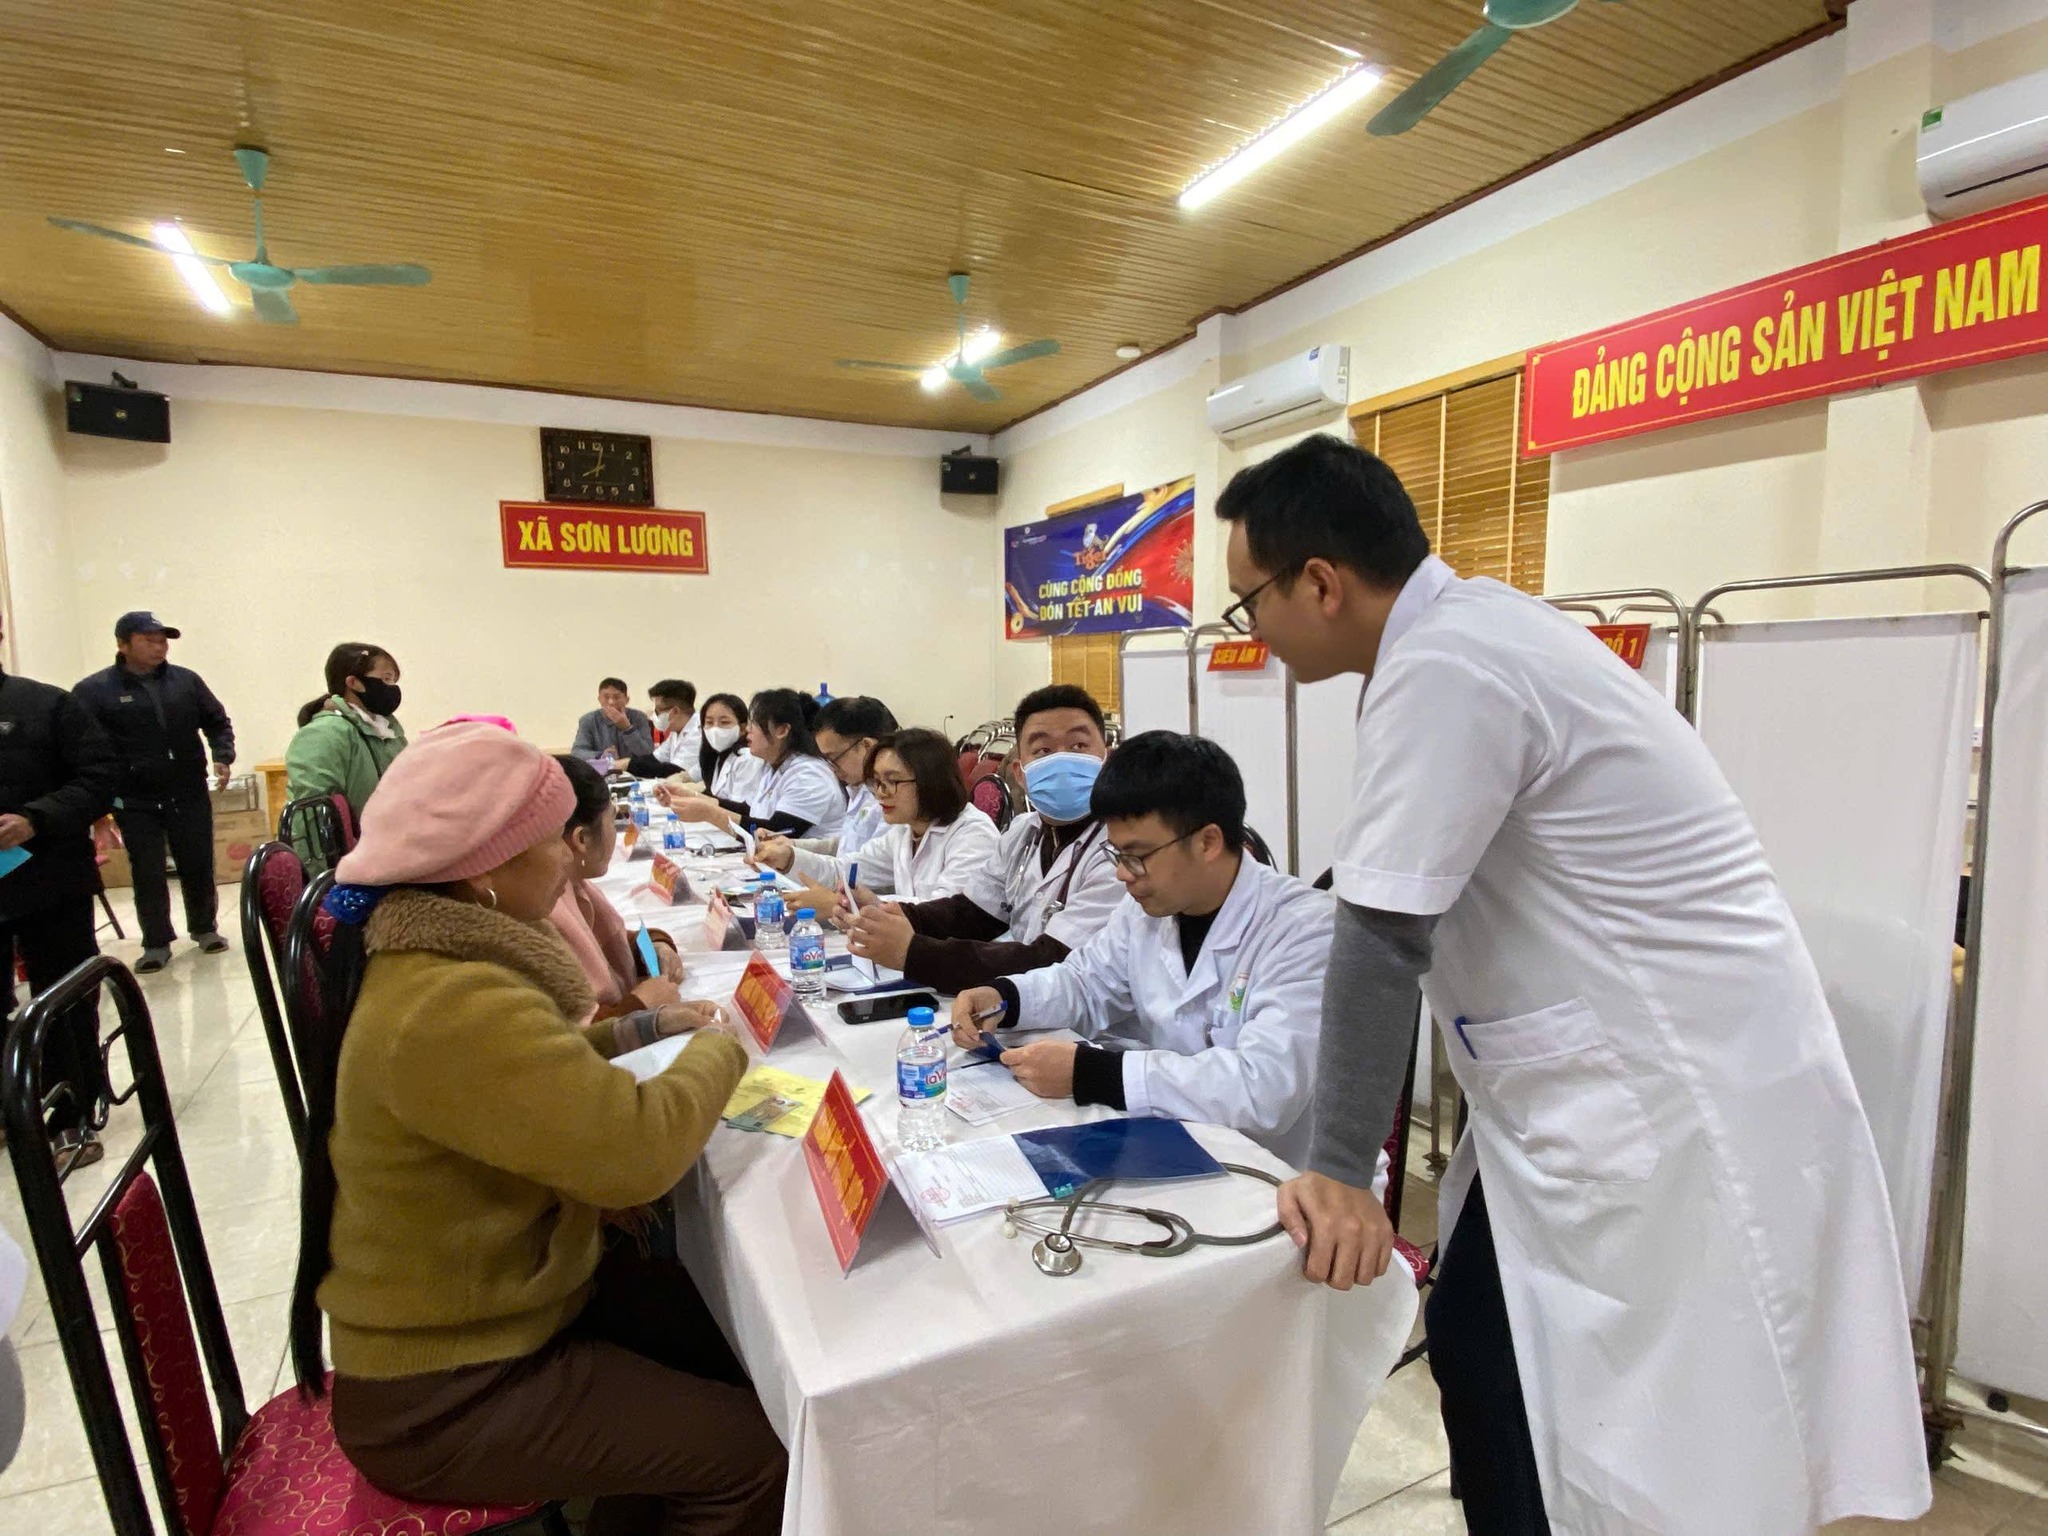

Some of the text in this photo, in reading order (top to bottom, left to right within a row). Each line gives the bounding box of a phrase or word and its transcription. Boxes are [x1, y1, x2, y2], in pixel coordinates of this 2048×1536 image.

[1572, 244, 2041, 419] ĐẢNG CỘNG SẢN VIỆT NAM
[518, 515, 694, 557] XÃ SƠN LƯƠNG
[1039, 565, 1142, 599] CÙNG CỘNG ĐỒNG
[1040, 593, 1142, 621] ĐÓN TẾT AN VUI
[1630, 637, 1638, 658] 1
